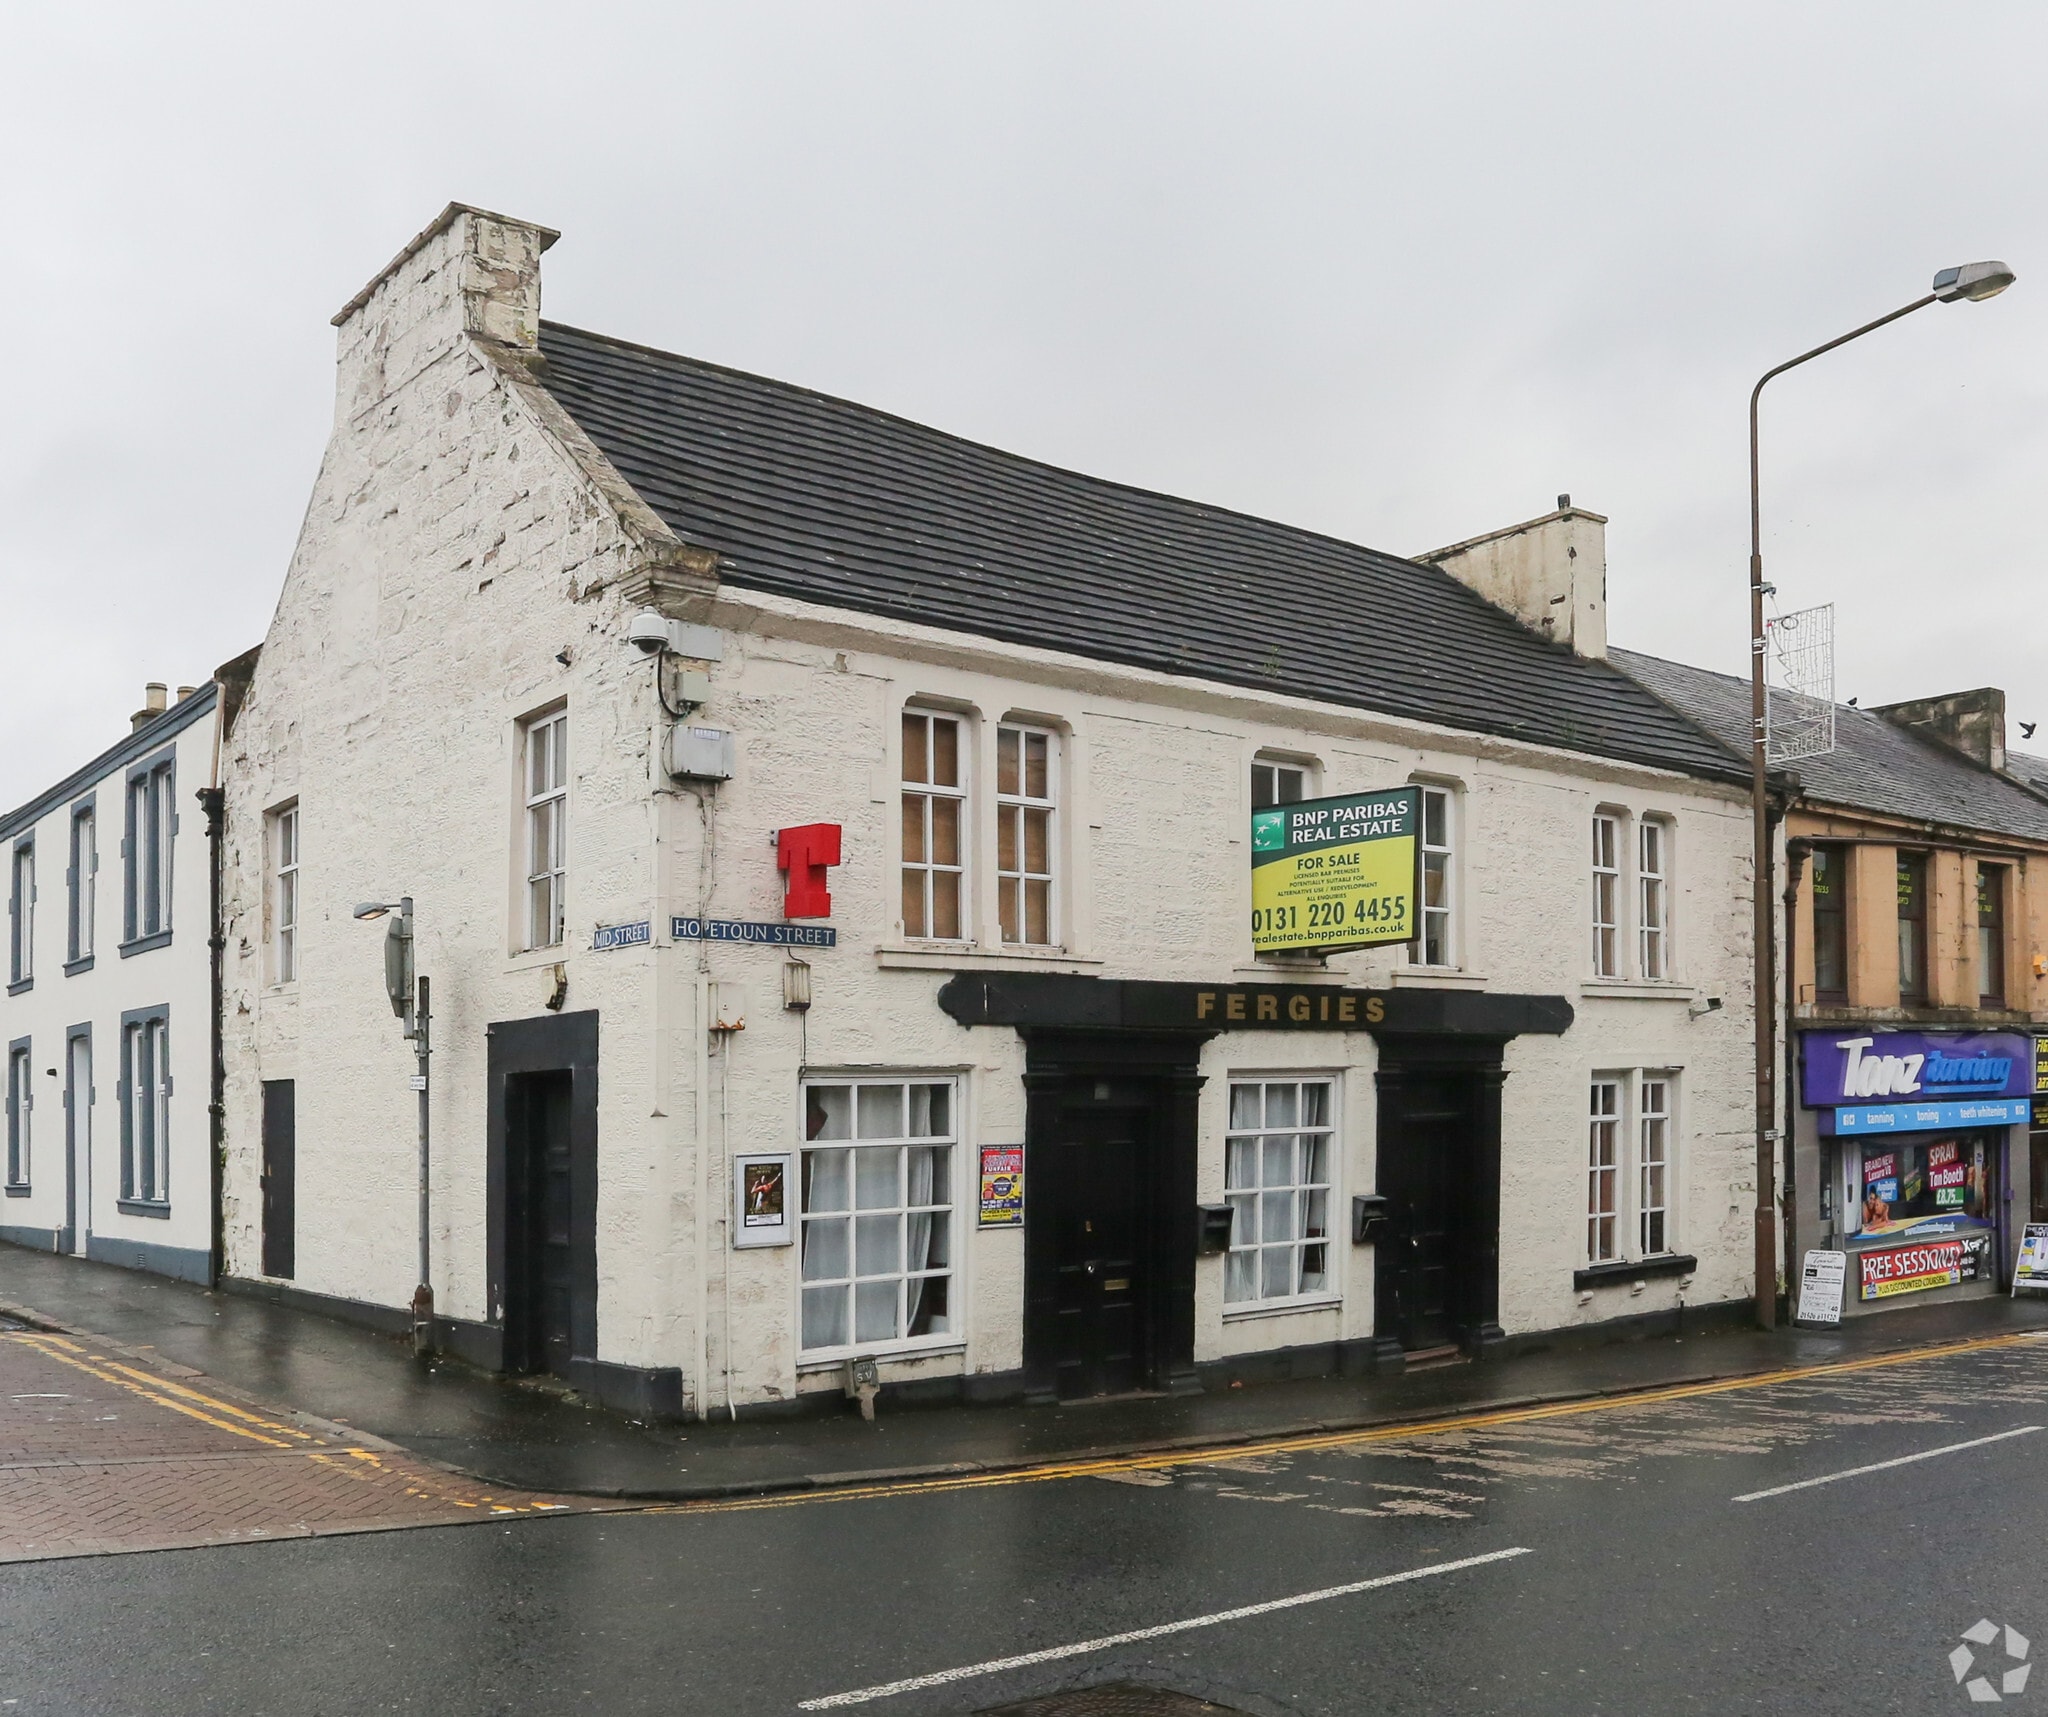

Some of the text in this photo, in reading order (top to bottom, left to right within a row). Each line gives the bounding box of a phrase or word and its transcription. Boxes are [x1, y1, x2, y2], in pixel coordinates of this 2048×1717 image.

[1293, 800, 1408, 827] BNP PARIBAS
[1292, 818, 1403, 844] REAL ESTATE
[1297, 853, 1360, 870] FOR SALE
[1289, 879, 1325, 888] POTENTIALLY
[1294, 872, 1319, 880] LICENSED
[1334, 868, 1360, 876] PREMISES
[1277, 887, 1312, 897] ALTERNATIVE
[1331, 882, 1378, 891] REDEVELOPMENT
[1317, 893, 1347, 901] ENQUIRIES
[1252, 896, 1405, 932] 0131 220 4455
[596, 923, 649, 948] MID STREET
[675, 921, 834, 945] HOPETOUN STREET
[1252, 922, 1405, 944] realestate.bnpparibas.co.uk
[1197, 992, 1387, 1023] FERGIES
[1836, 1037, 2012, 1097] Tanz tanning
[1867, 1104, 2008, 1126] tanning toning teeth whitening
[1865, 1153, 1894, 1173] BRAND NEW
[1930, 1141, 1956, 1166] SPRAY
[1930, 1166, 1964, 1187] Tan Booth
[1936, 1188, 1956, 1205] £8.75
[1863, 1255, 1893, 1281] FREE
[1895, 1246, 1961, 1276] SESSIONS!
[1890, 1278, 1922, 1293] DISCOUNTED
